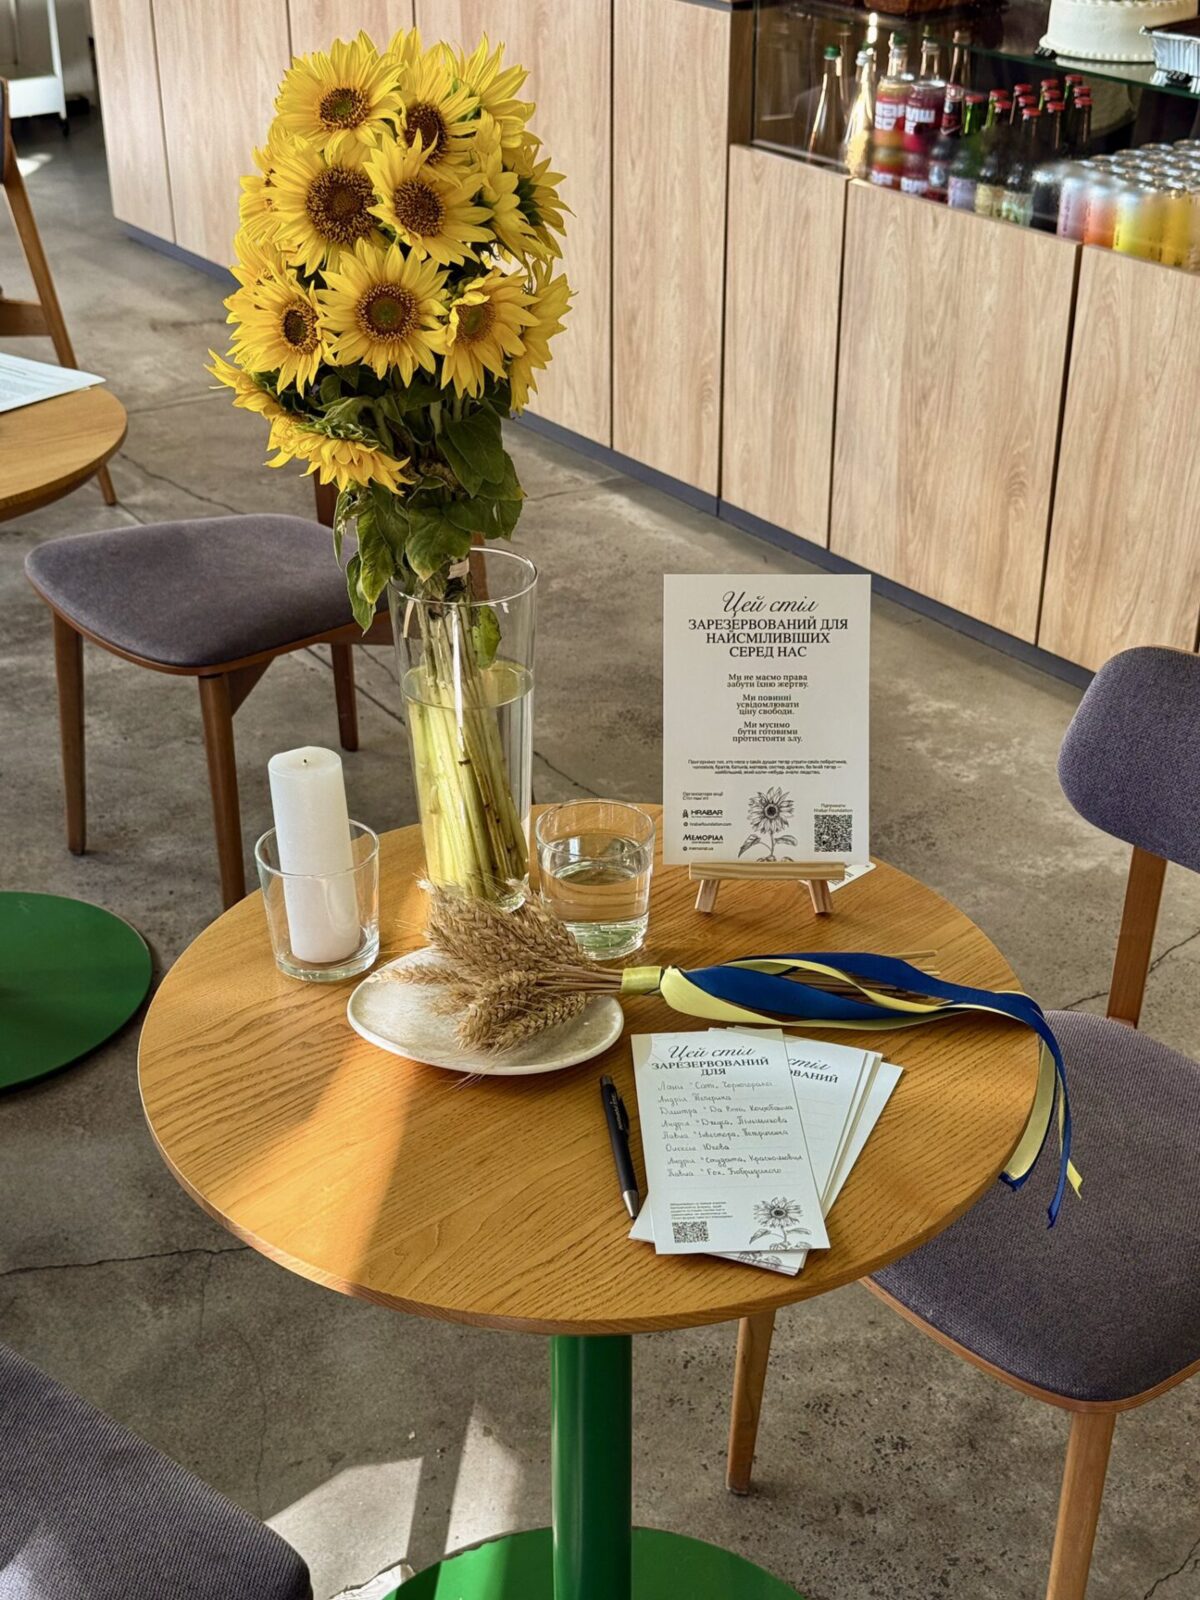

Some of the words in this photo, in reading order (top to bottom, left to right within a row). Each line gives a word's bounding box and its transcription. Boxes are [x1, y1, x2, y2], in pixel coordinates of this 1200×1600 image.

[722, 591, 767, 618] Цей
[769, 596, 819, 613] стіл
[688, 616, 817, 630] ЗАРЕЗЕРВОВАНИЙ
[820, 619, 848, 632] ДЛЯ
[706, 630, 830, 644] НАЙСМІЛИВІШИХ
[729, 646, 774, 658] СЕРЕД
[777, 646, 807, 658] НАС
[783, 675, 808, 683] права
[727, 680, 755, 689] забути
[756, 680, 776, 688] їхню
[777, 681, 809, 689] жертву.
[736, 701, 800, 709] усвідомлювати
[739, 708, 757, 716] ціну
[758, 707, 795, 715] свободи.
[759, 722, 790, 730] мусимо
[737, 728, 757, 736] бути
[732, 735, 786, 744] протистояти
[787, 736, 803, 744] злу.
[668, 1045, 708, 1061] Цей
[711, 1046, 756, 1057] стіл
[652, 1057, 769, 1070] ЗАРЕЗЕРВОВАНИЙ
[700, 1068, 726, 1077] ДЛЯ
